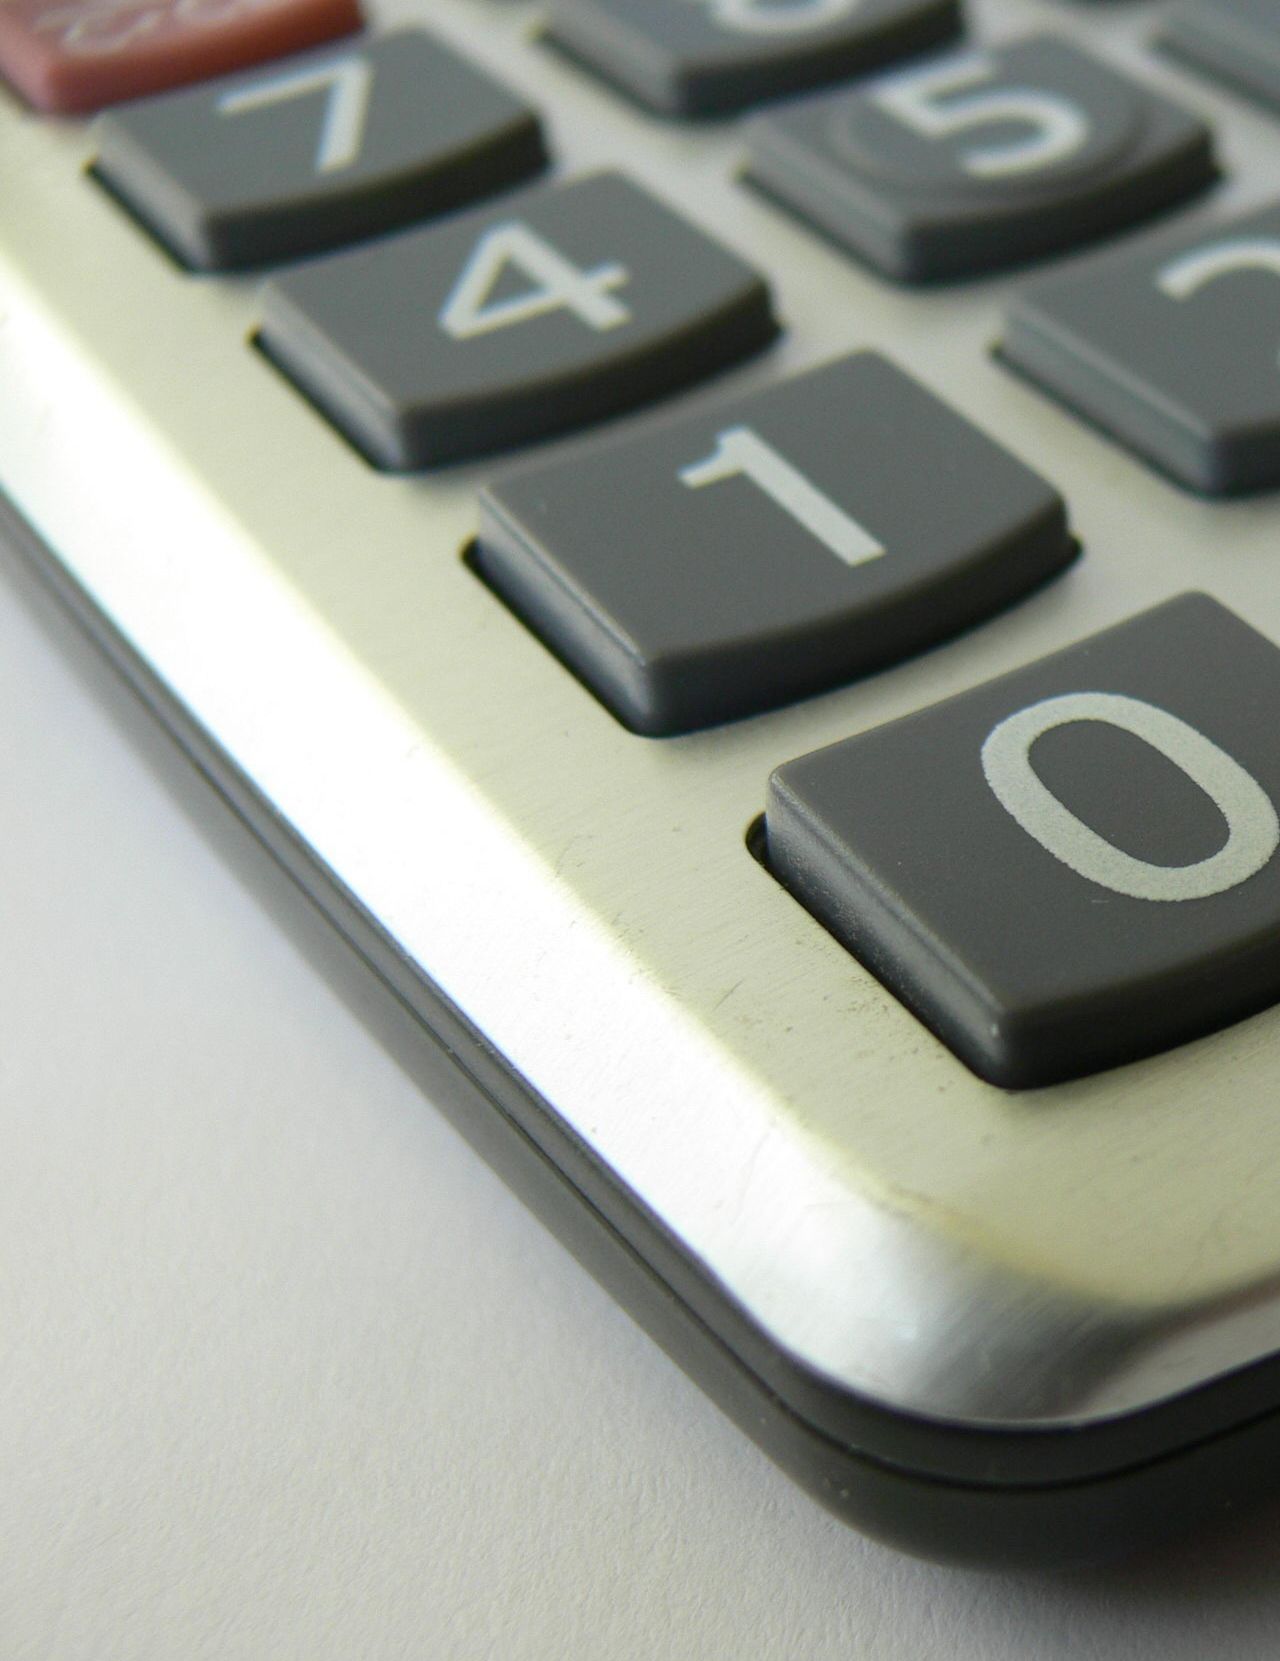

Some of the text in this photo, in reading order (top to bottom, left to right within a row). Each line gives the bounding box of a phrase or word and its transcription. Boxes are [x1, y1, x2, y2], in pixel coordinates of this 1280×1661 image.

[217, 55, 373, 173] 7
[868, 52, 1090, 177] 5
[440, 222, 628, 339] 4
[680, 428, 884, 566] 1
[981, 691, 1280, 902] 0
